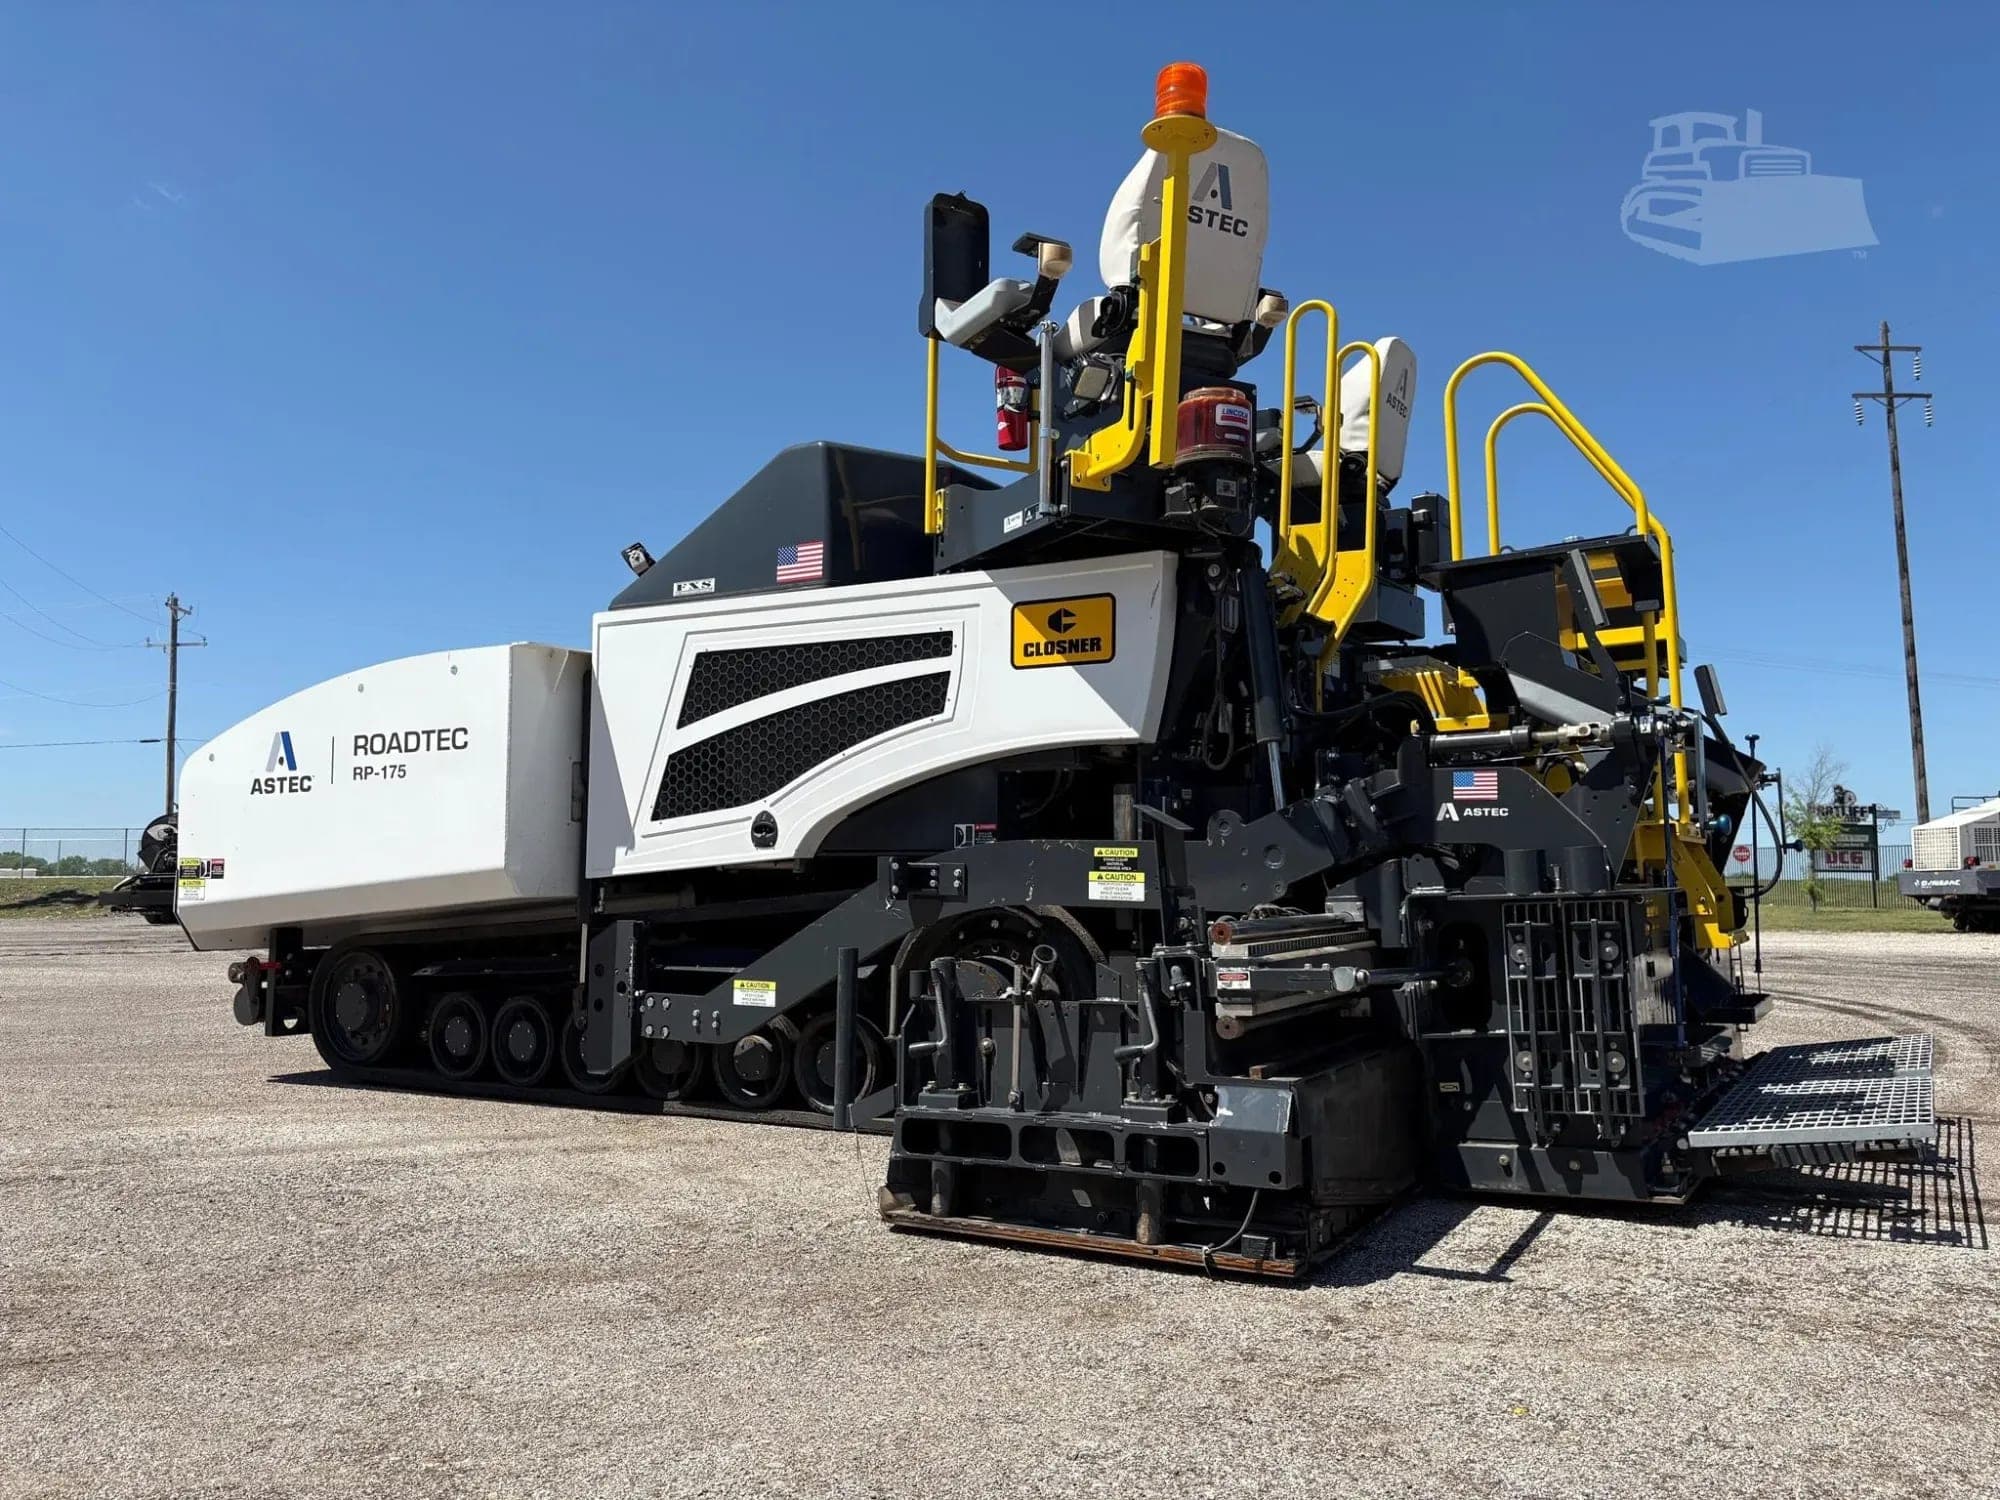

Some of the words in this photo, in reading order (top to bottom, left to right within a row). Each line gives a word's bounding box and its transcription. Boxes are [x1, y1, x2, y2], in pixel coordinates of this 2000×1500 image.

[1187, 205, 1249, 237] STEC
[1386, 392, 1408, 418] ASTEC
[1023, 637, 1102, 657] CLOSNER
[353, 727, 468, 756] ROADTEC
[352, 764, 407, 781] RP-175
[250, 775, 312, 795] ASTEC
[1463, 807, 1509, 817] ASTEC
[1105, 873, 1137, 881] CAUTION
[746, 981, 770, 989] CAUTION
